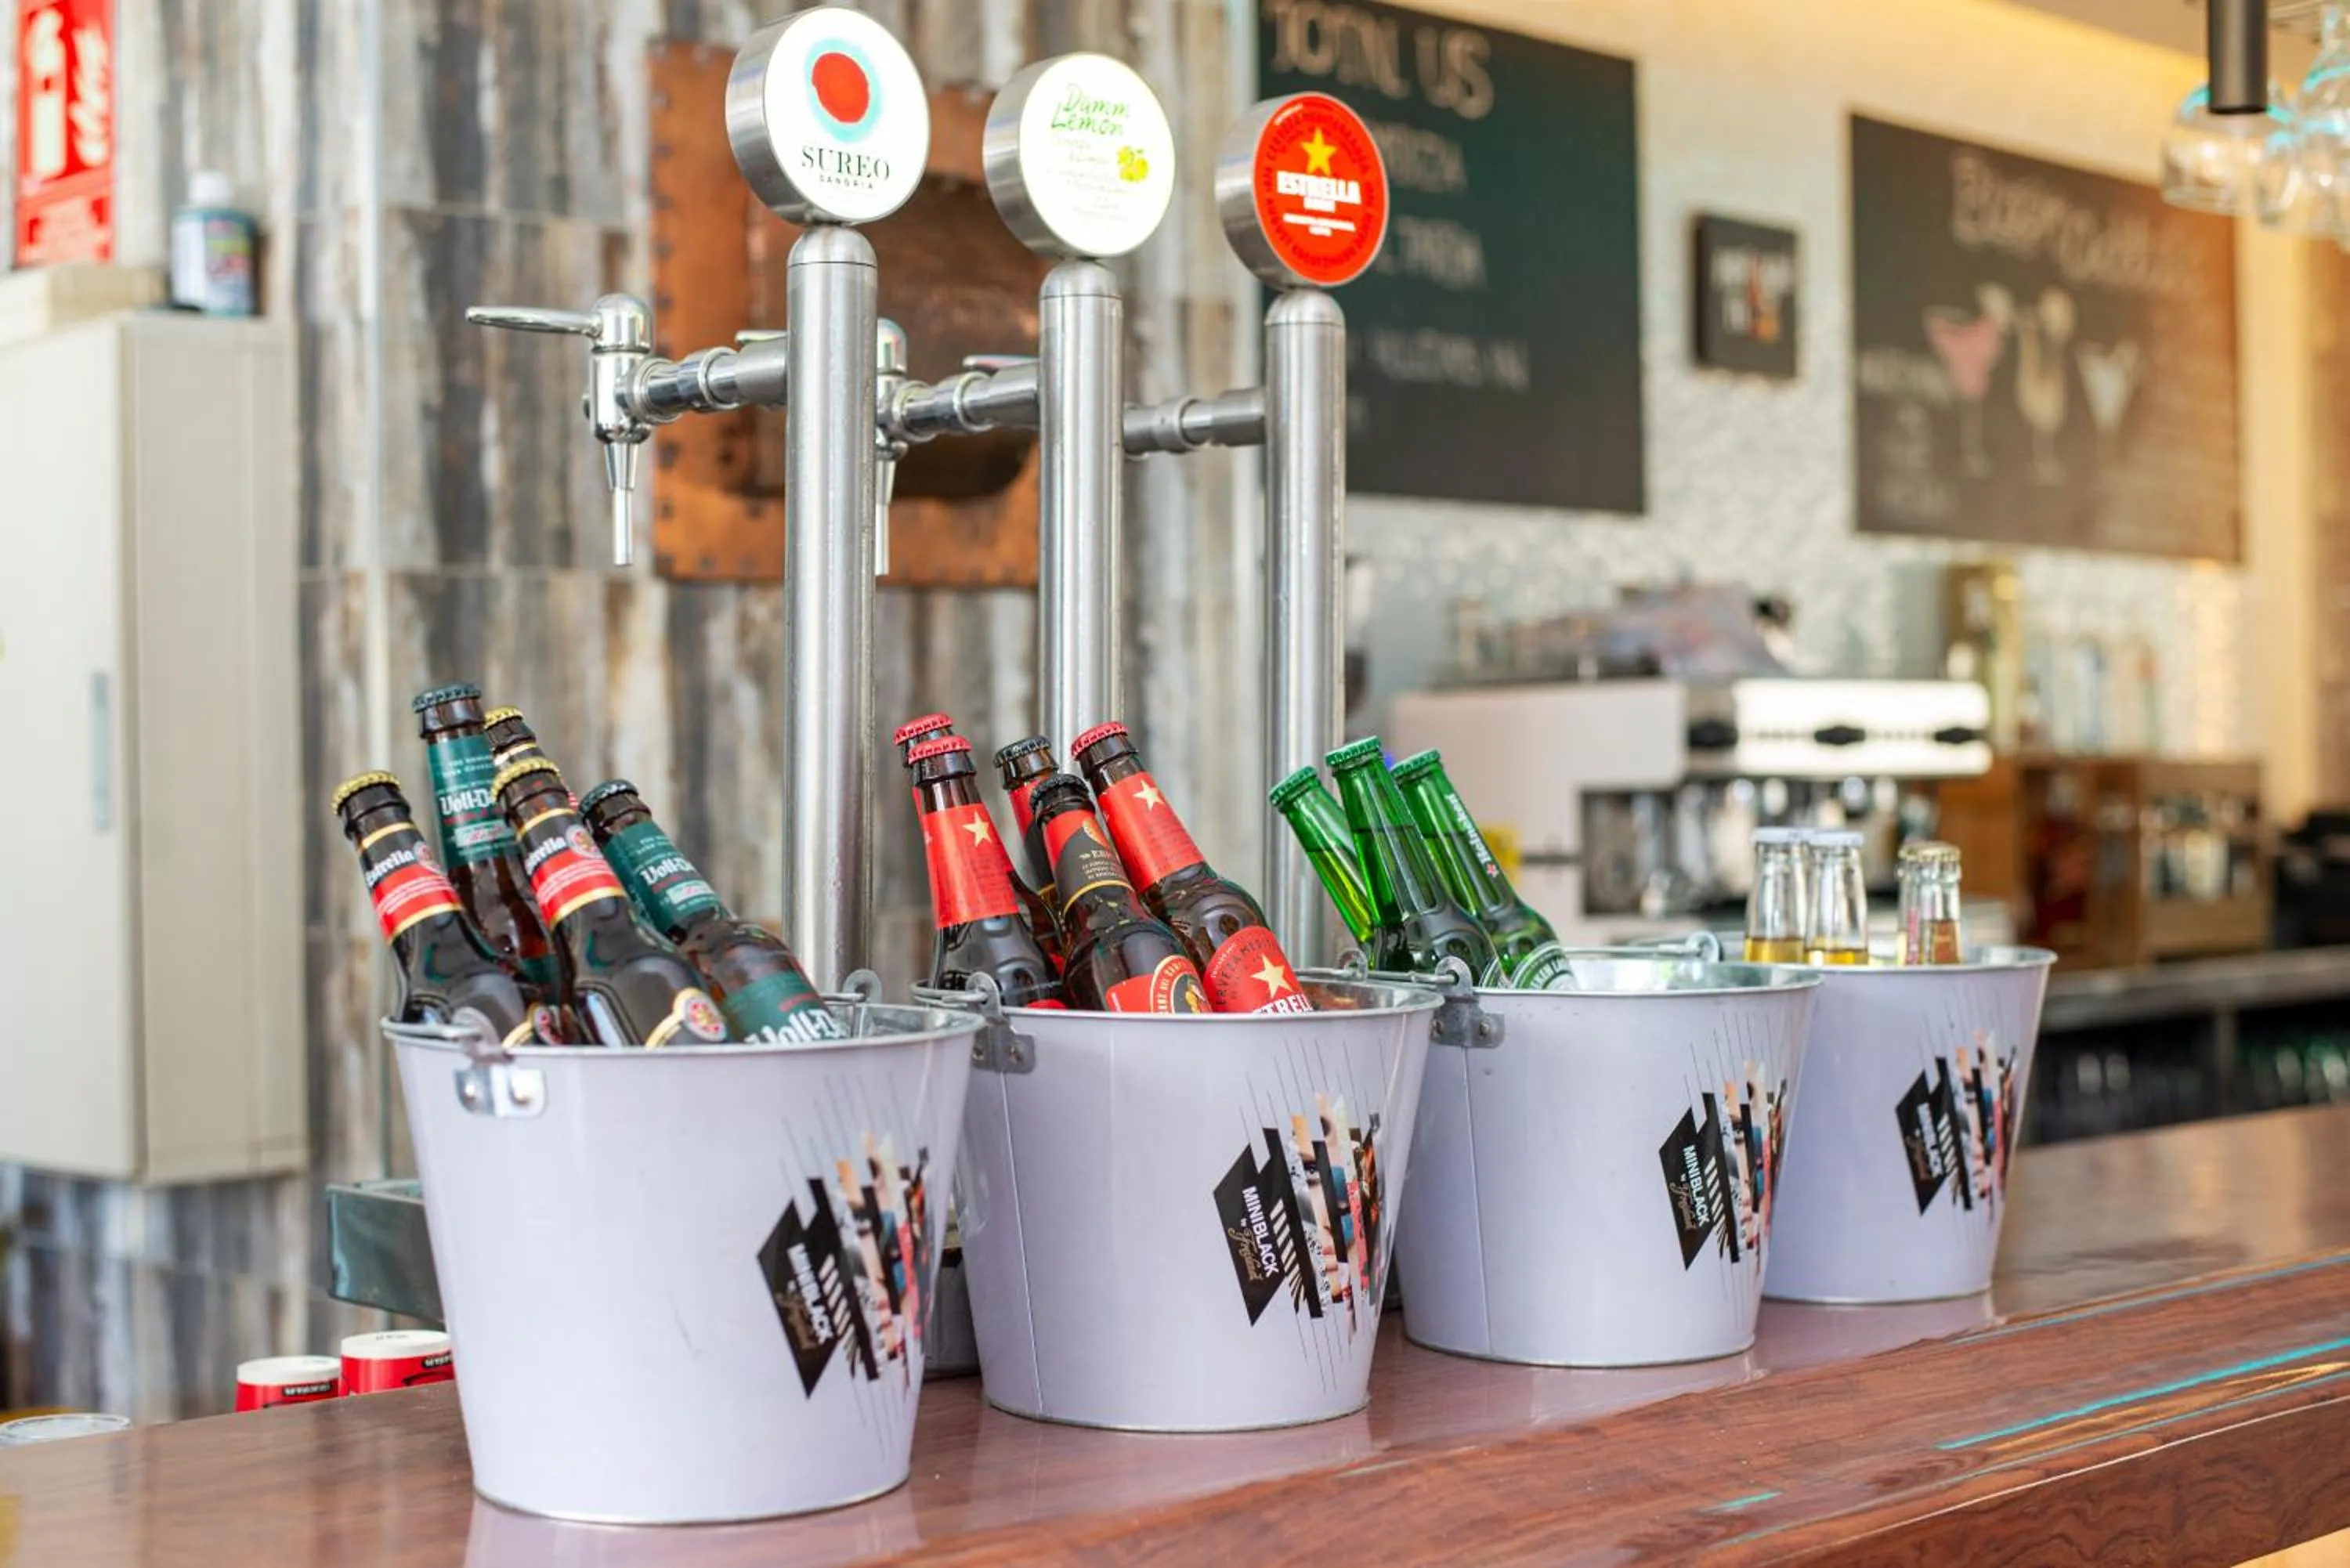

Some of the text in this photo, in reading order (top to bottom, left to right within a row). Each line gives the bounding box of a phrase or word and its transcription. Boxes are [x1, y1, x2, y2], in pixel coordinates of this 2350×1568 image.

[1415, 27, 1493, 119] US
[1064, 83, 1130, 118] Damm
[1051, 102, 1123, 135] Lemon
[801, 146, 890, 180] SUREO
[1277, 171, 1362, 204] ESTRELLA
[439, 788, 490, 815] Voll-D
[1683, 1144, 1710, 1227] MINIBLACK
[1242, 1186, 1279, 1277] MINIBLACK
[787, 1243, 833, 1345] MINIBLACK
